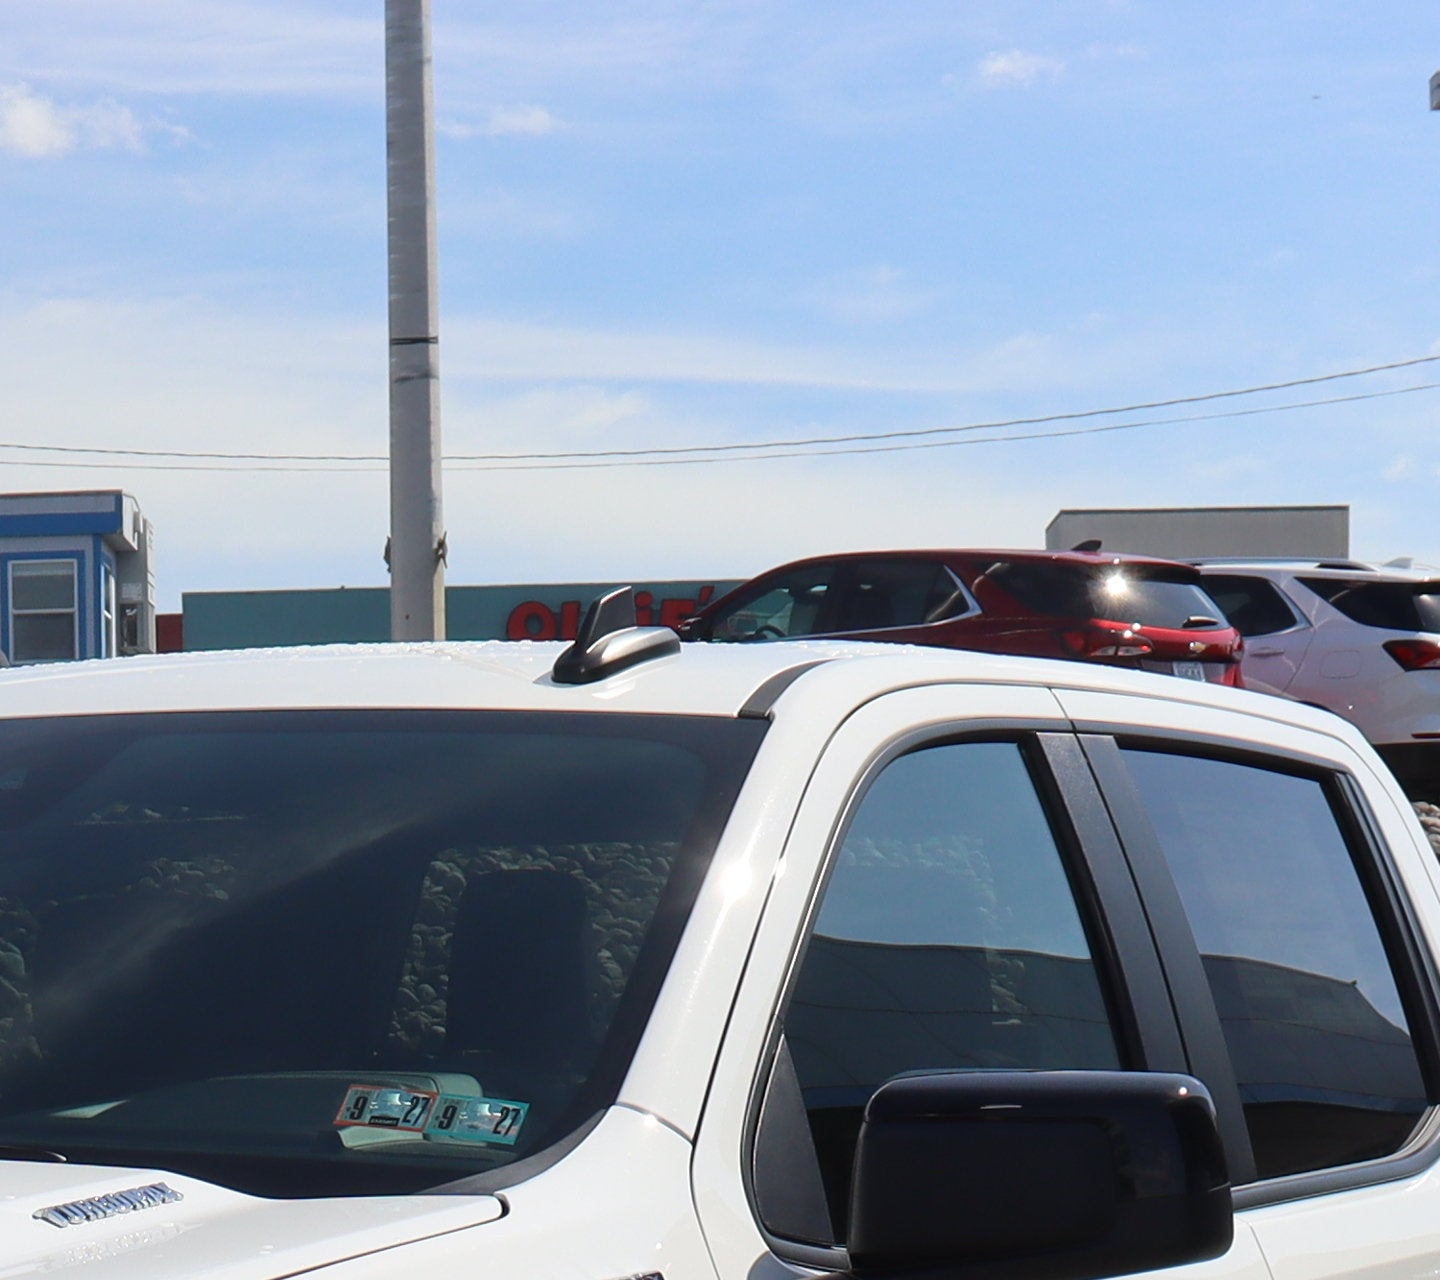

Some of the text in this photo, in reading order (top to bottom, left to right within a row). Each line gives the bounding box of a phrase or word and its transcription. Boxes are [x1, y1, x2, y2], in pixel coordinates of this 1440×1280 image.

[349, 1096, 431, 1126] 9 27
[438, 1104, 521, 1138] 9 27
